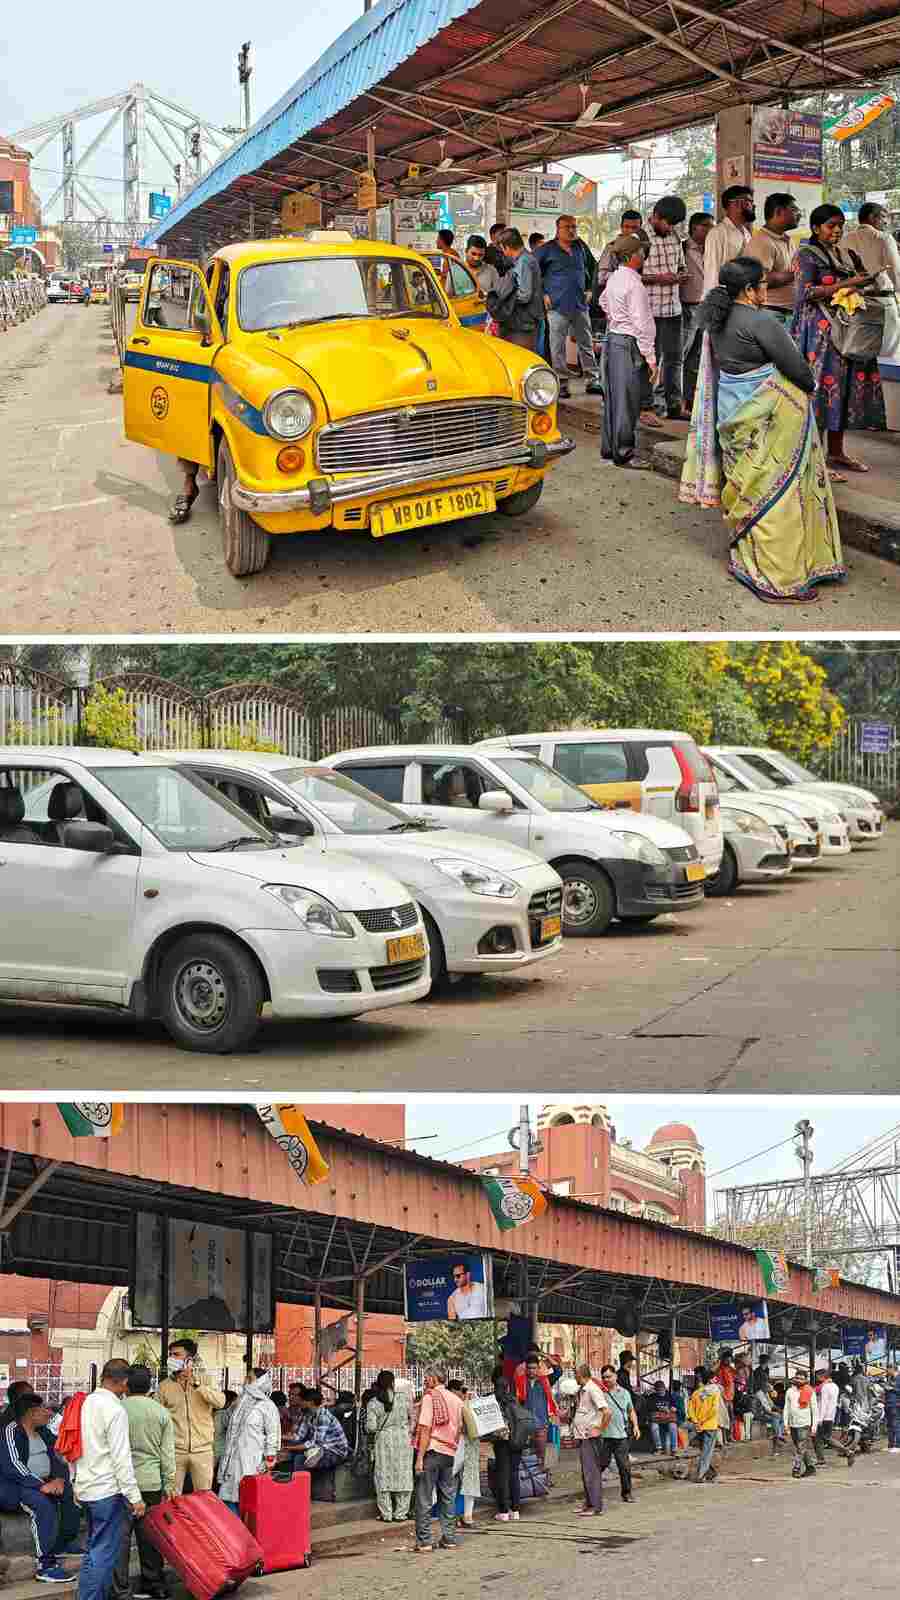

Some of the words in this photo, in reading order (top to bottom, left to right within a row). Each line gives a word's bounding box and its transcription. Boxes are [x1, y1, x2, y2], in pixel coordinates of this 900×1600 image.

[393, 505, 412, 525] WB
[448, 491, 483, 512] 1802
[416, 1277, 447, 1288] DOLLAR
